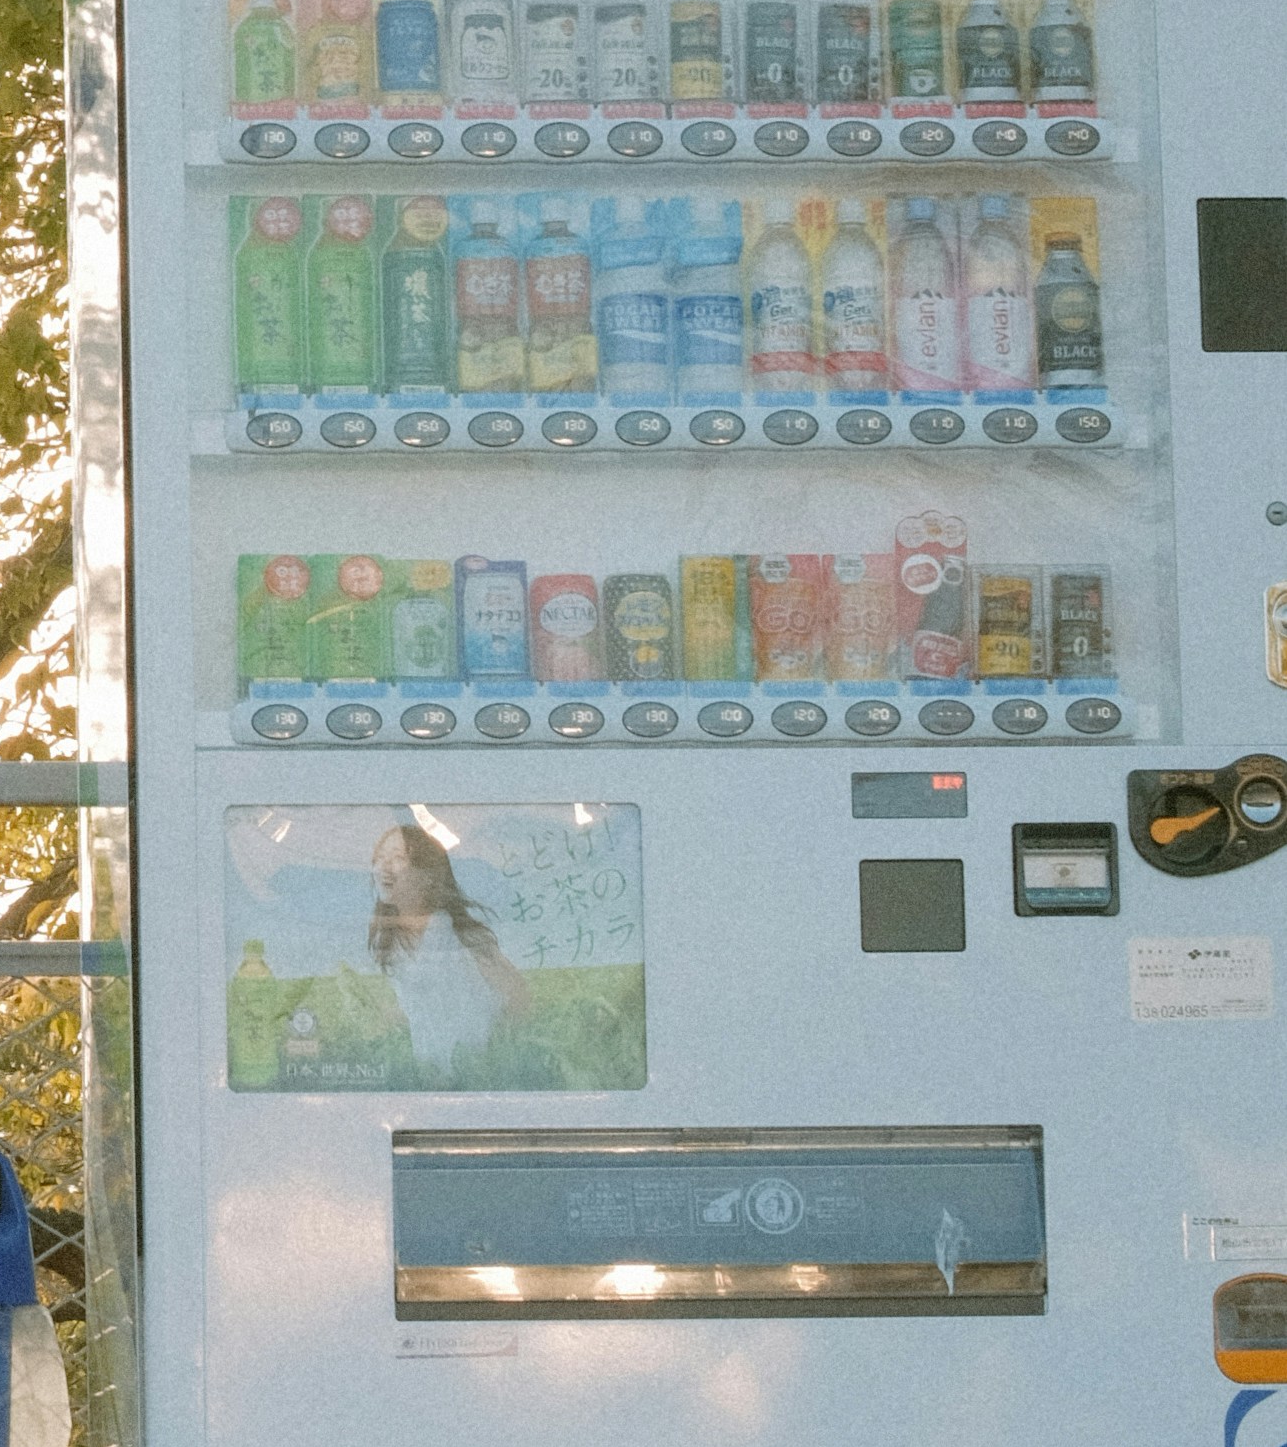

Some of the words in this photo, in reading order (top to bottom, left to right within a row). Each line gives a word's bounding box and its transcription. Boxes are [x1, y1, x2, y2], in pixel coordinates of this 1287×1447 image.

[993, 298, 1010, 356] evian
[1053, 345, 1096, 359] BLACK
[511, 867, 627, 925] お茶の
[522, 914, 635, 969] チカラ
